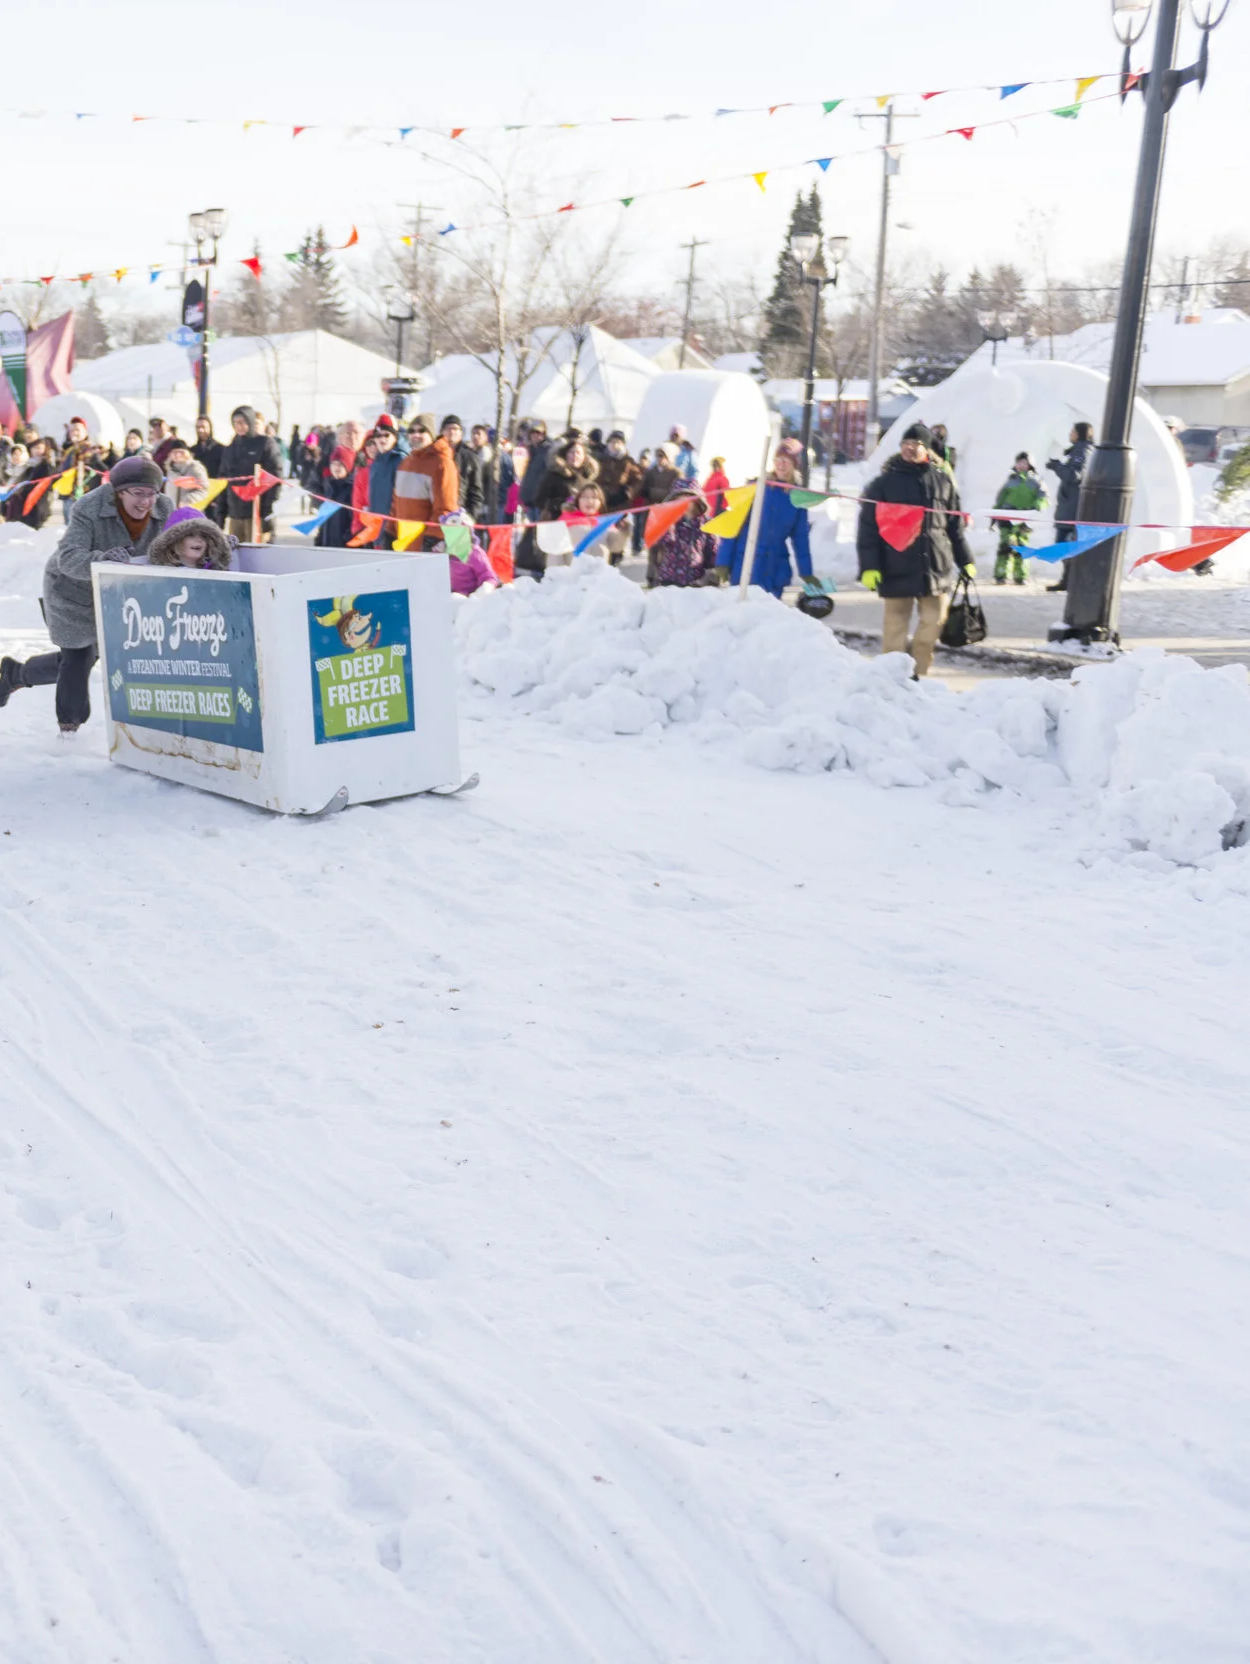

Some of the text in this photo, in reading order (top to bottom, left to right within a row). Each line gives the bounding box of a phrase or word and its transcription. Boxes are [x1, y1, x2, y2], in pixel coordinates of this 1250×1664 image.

[122, 585, 227, 657] Deep Freeze
[132, 659, 171, 675] BYZANTINE
[171, 660, 201, 676] WINTER
[201, 662, 232, 677] FESTIVAL
[340, 653, 384, 680] DEEP
[128, 688, 231, 718] DEEP FREEZER RACES
[328, 674, 402, 707] FREEZER
[345, 700, 390, 728] RACE
